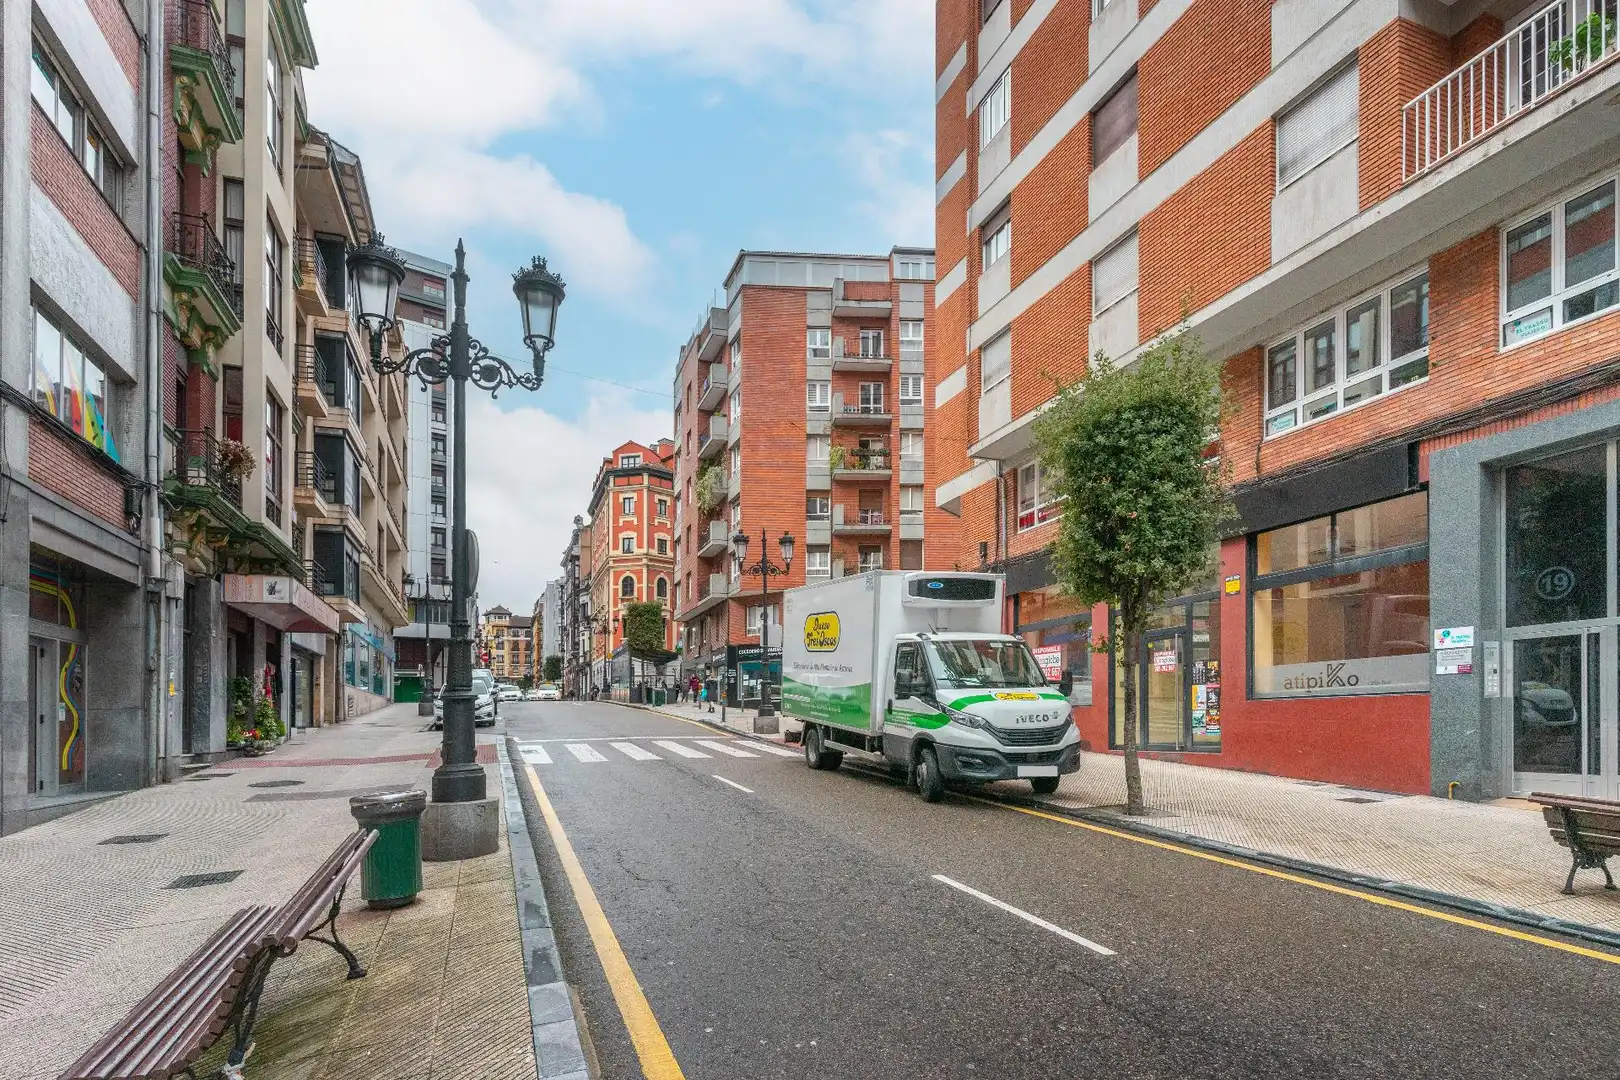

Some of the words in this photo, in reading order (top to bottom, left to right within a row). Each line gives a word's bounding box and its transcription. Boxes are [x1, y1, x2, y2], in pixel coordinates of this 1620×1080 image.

[1542, 573, 1569, 593] 19
[1284, 662, 1359, 690] atipiKo
[1016, 713, 1050, 724] IVECO
